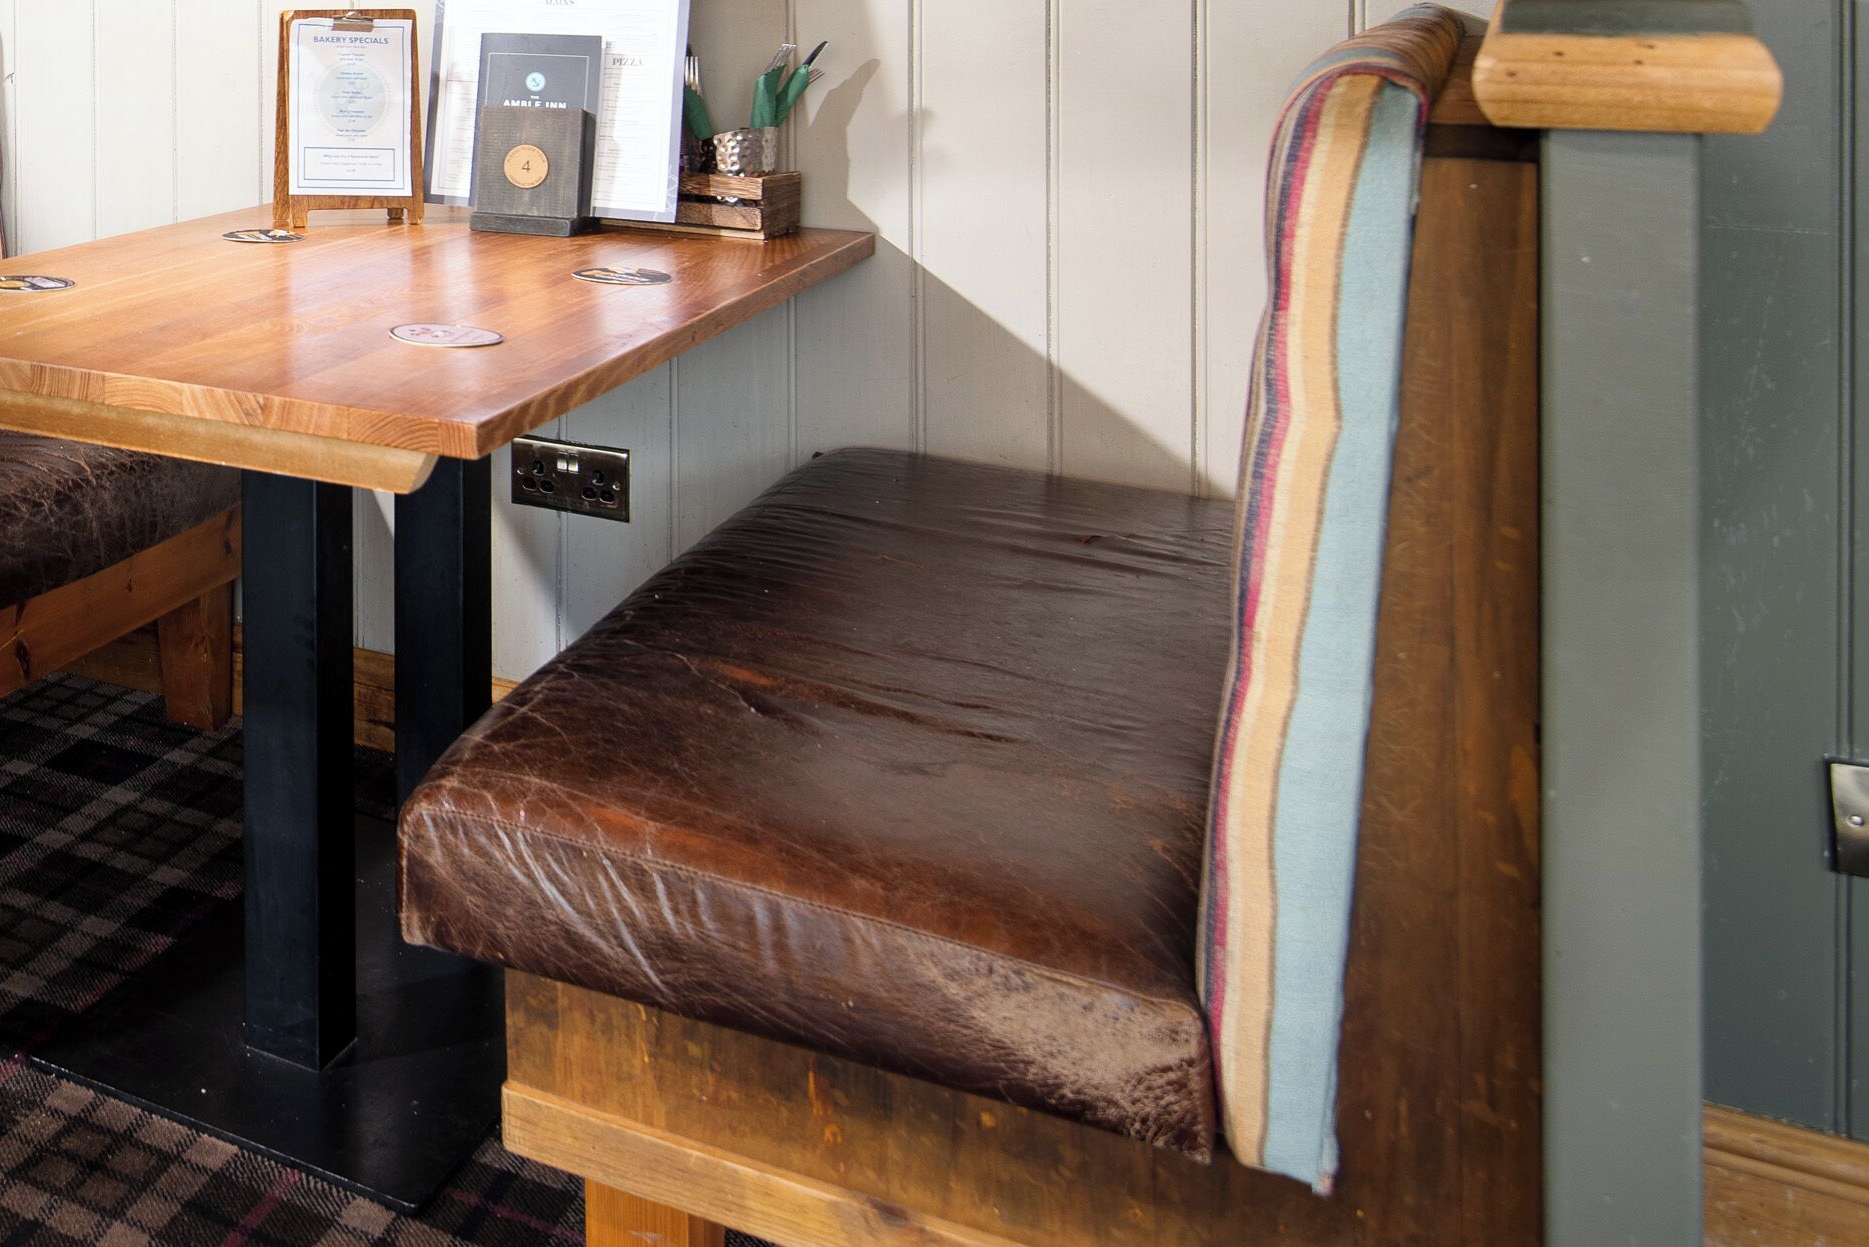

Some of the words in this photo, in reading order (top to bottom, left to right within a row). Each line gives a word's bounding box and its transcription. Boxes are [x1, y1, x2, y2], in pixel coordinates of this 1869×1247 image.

[313, 35, 347, 44] BAKERY
[349, 36, 389, 45] SPECIALS
[612, 57, 643, 67] PIZZA
[521, 159, 531, 173] 4
